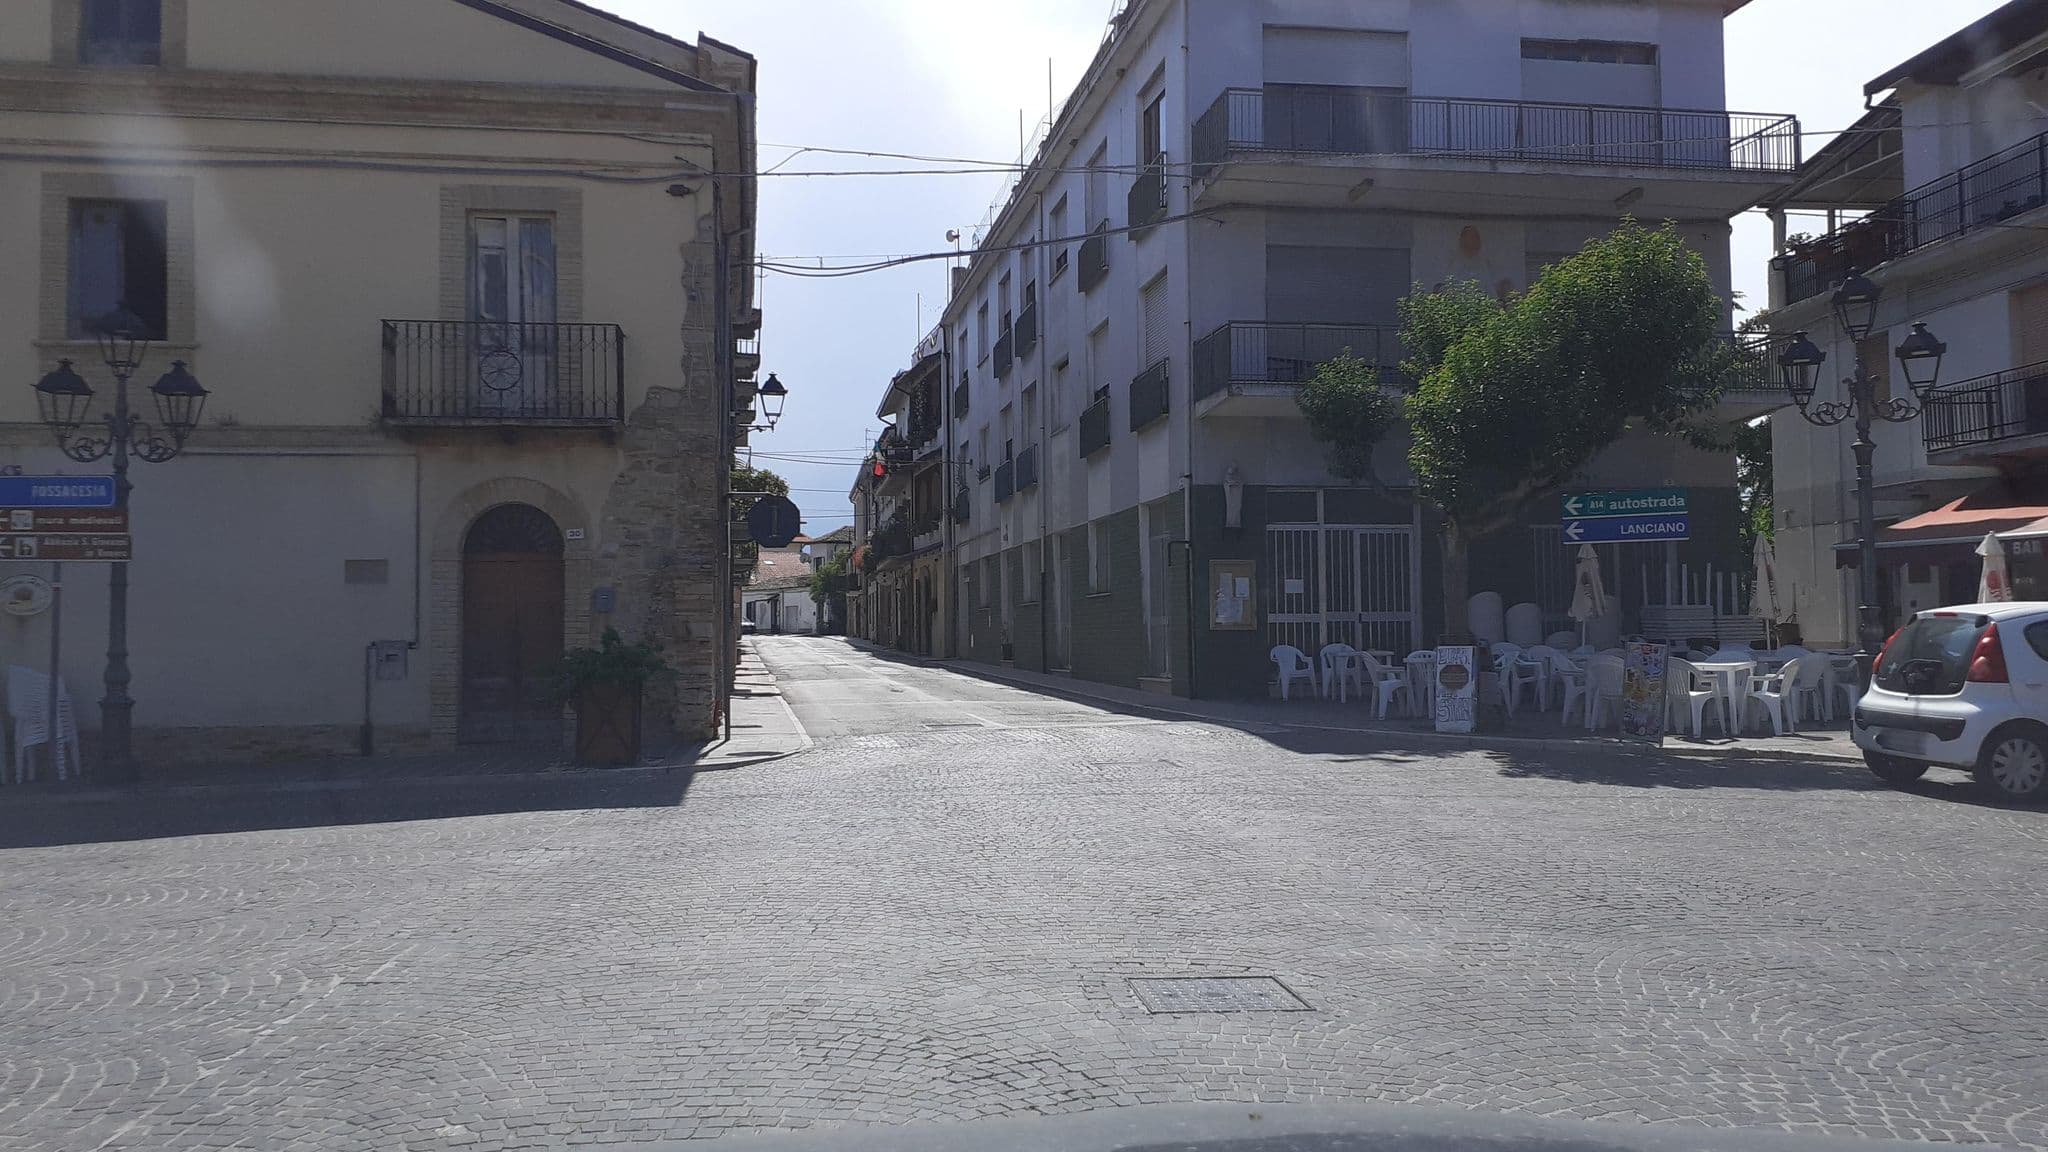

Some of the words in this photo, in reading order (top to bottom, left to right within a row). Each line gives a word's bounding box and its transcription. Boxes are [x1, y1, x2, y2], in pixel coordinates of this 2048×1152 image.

[31, 485, 107, 497] FOSSACESIA
[1589, 500, 1604, 509] A14
[1609, 495, 1685, 510] autostrada
[1620, 522, 1686, 535] LANCIANO
